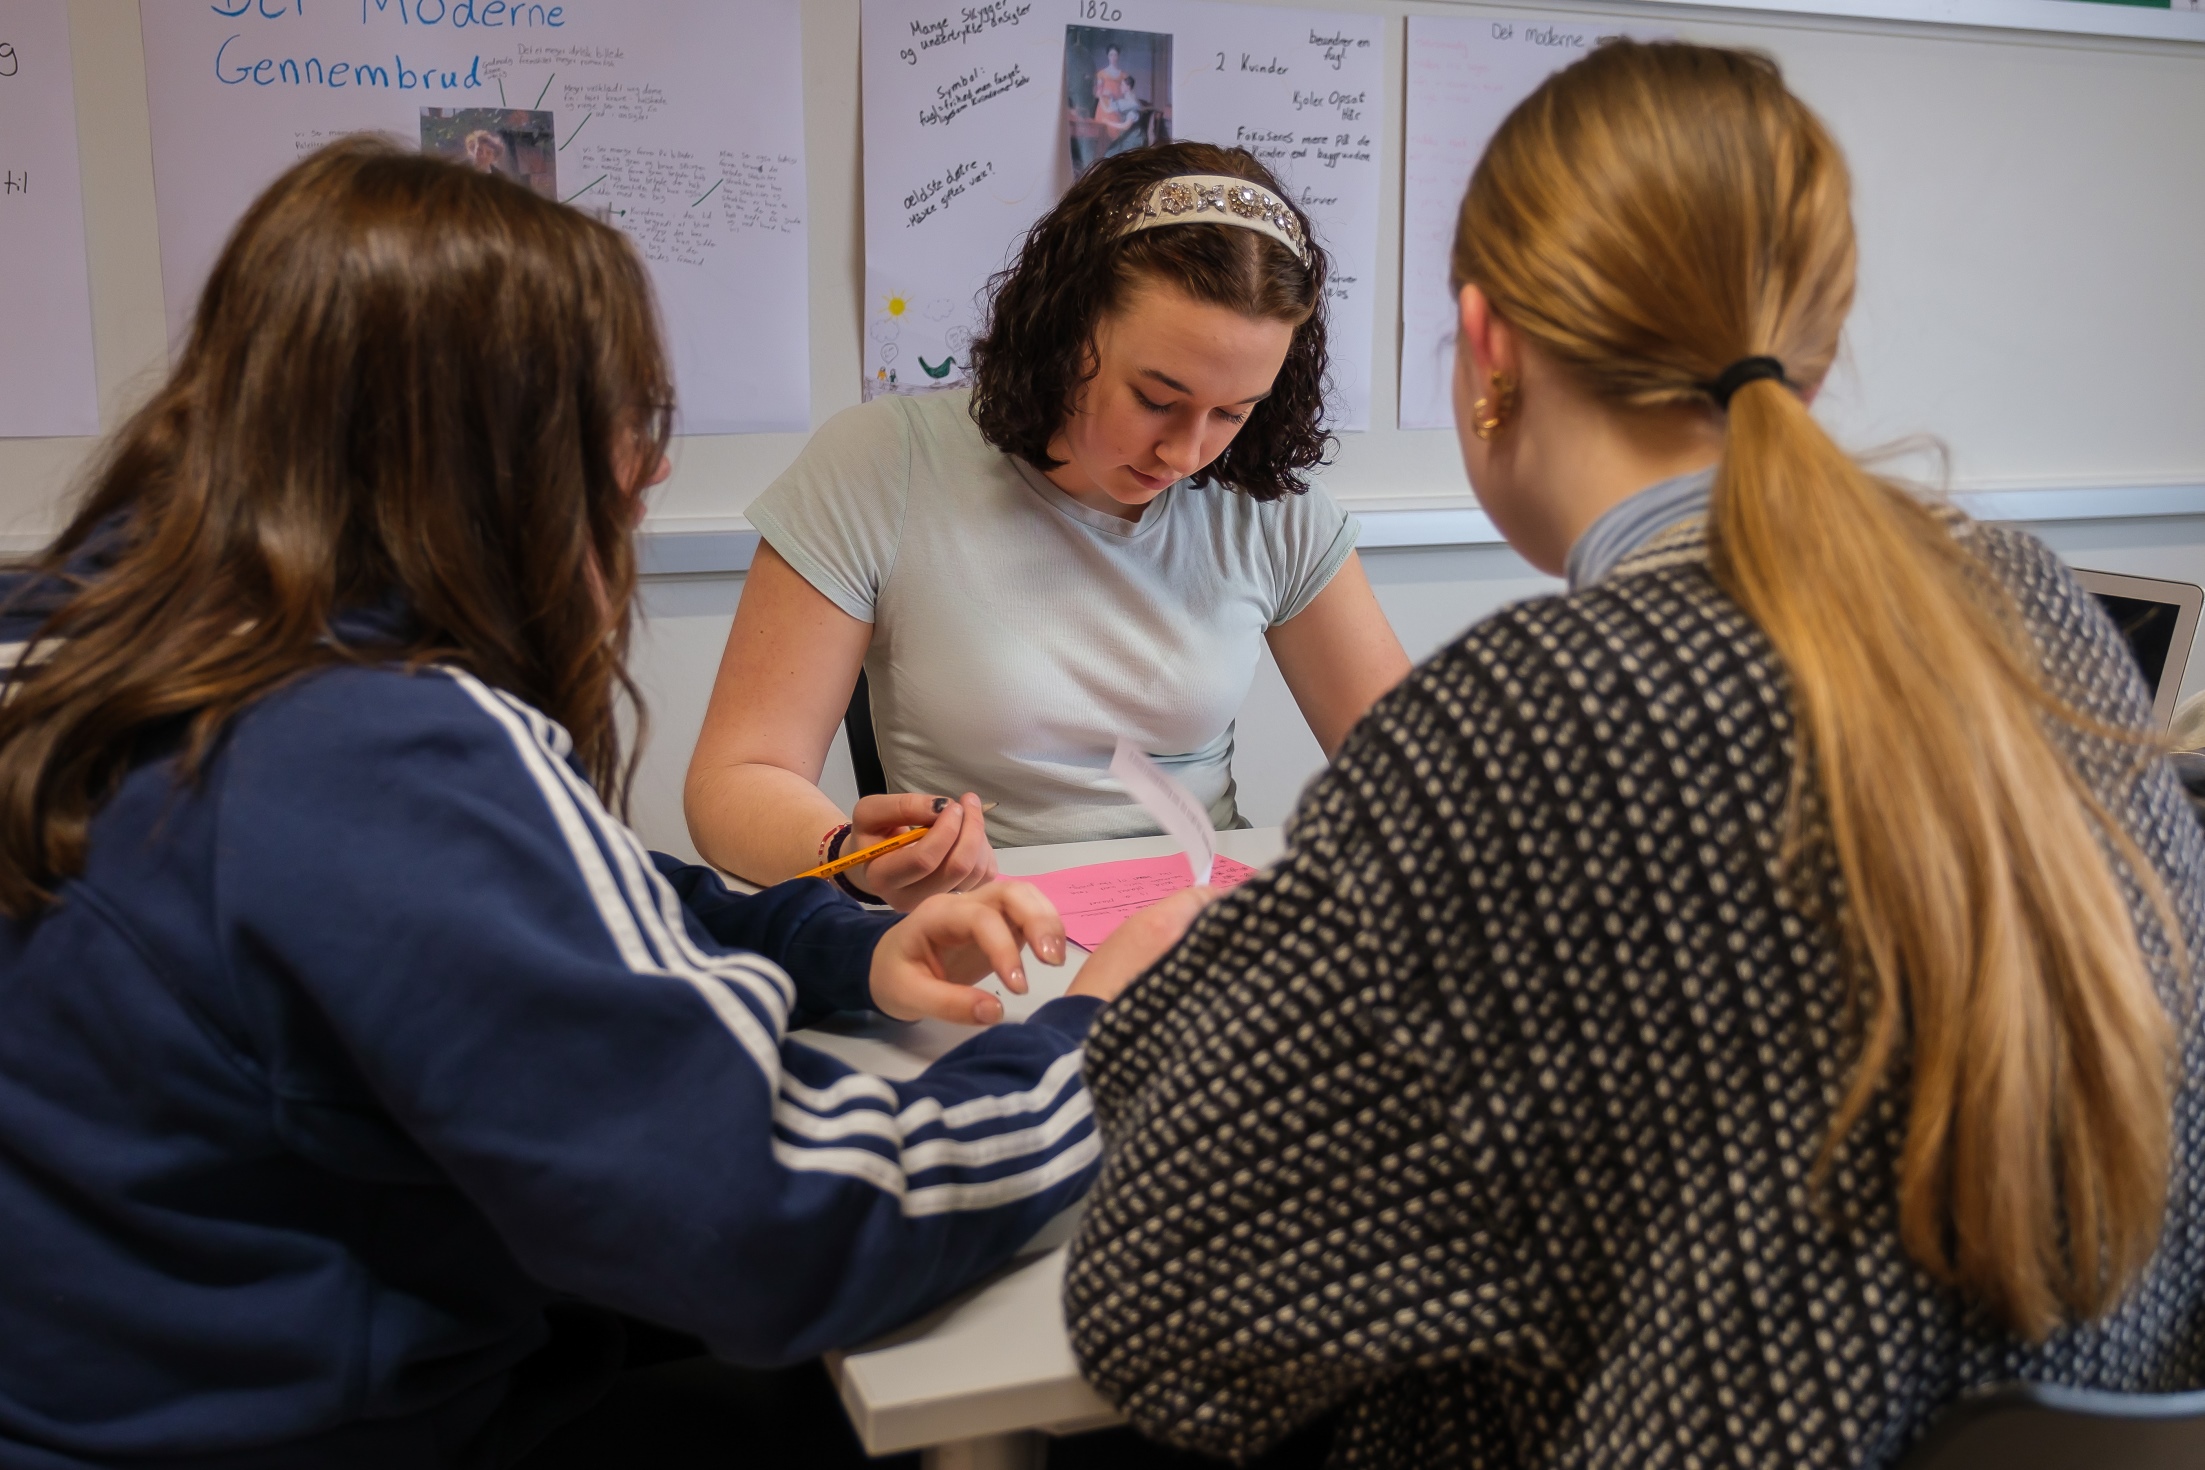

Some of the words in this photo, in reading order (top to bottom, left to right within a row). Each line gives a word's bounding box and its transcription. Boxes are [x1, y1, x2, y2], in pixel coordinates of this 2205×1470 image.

[1079, 0, 1122, 21] 1820
[910, 18, 948, 37] Mange
[1491, 22, 1513, 40] Det
[1357, 39, 1370, 47] en
[216, 34, 482, 89] Gennembrud
[900, 48, 917, 65] og
[1216, 52, 1225, 71] 2
[1241, 53, 1288, 75] Kvinder
[4, 170, 27, 195] til
